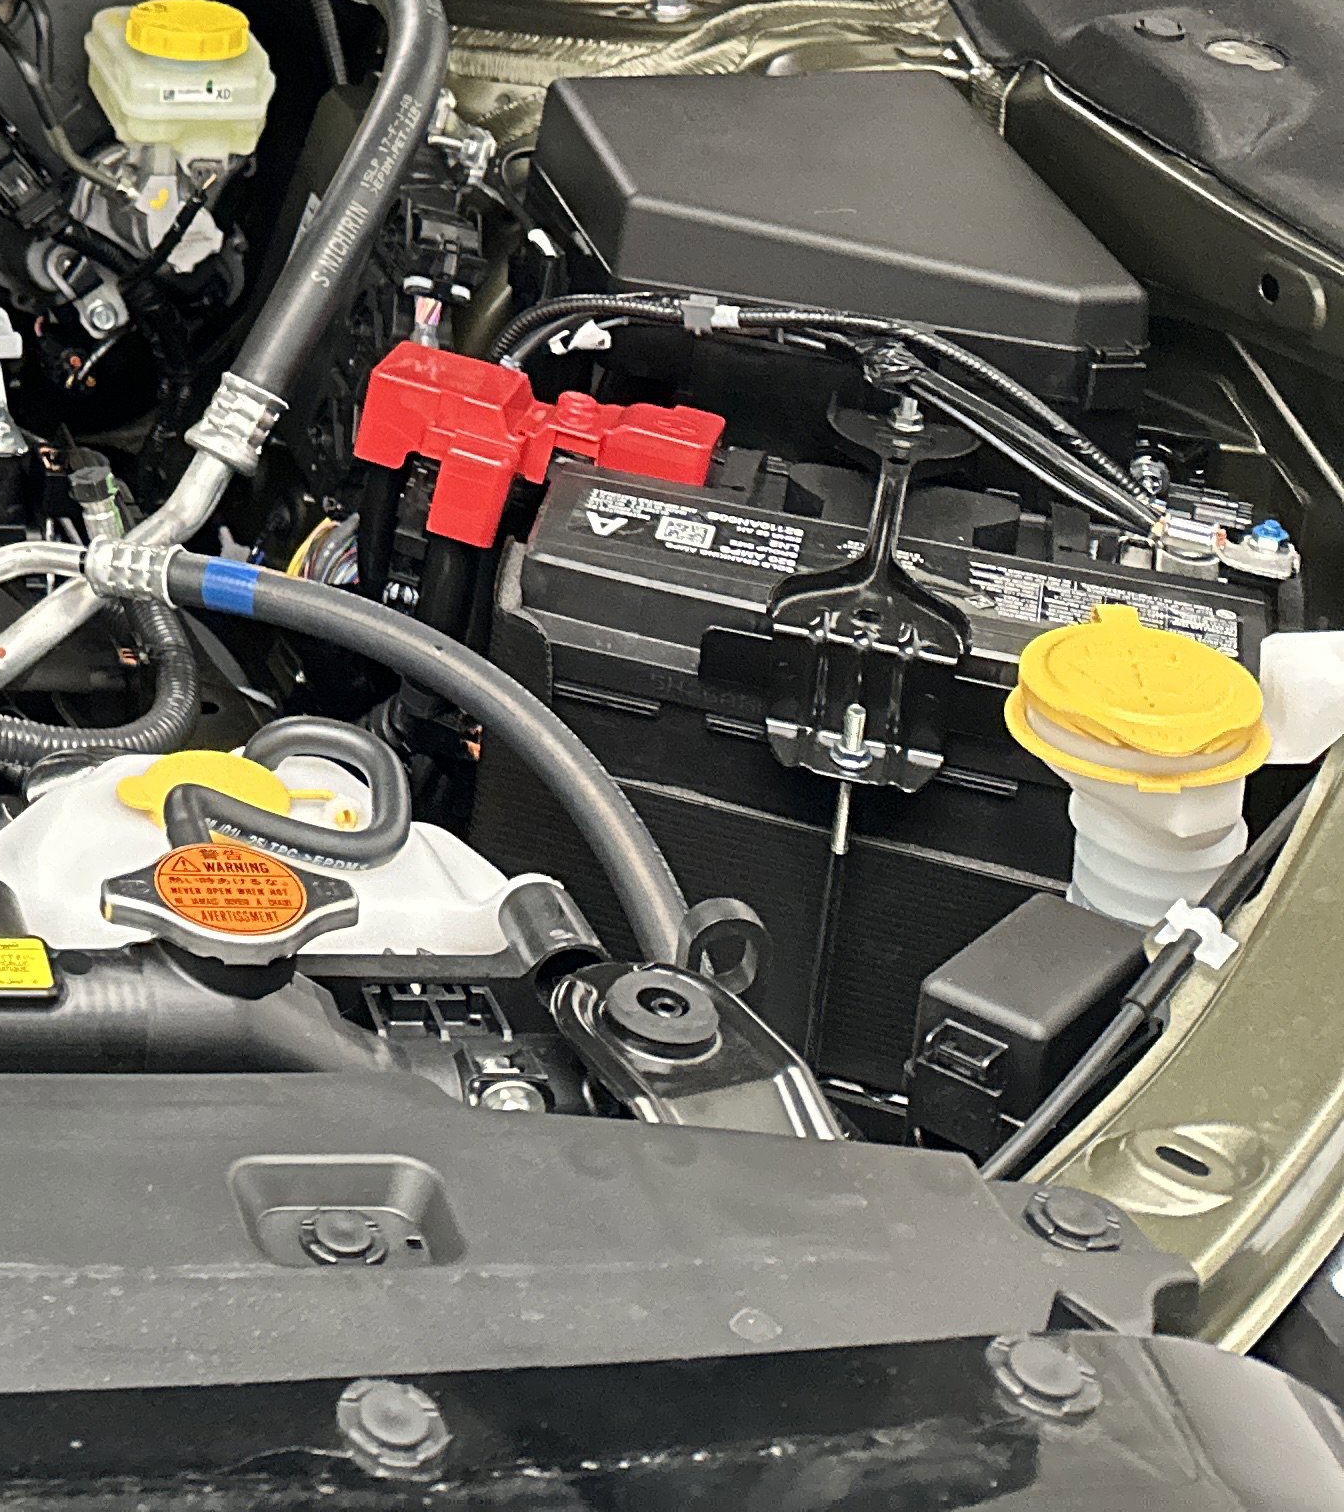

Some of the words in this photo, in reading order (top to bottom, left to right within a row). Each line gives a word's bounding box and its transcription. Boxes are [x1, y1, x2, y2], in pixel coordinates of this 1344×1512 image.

[202, 862, 270, 874] WARNING
[171, 887, 201, 895] NEVER
[206, 887, 232, 895] OPEN
